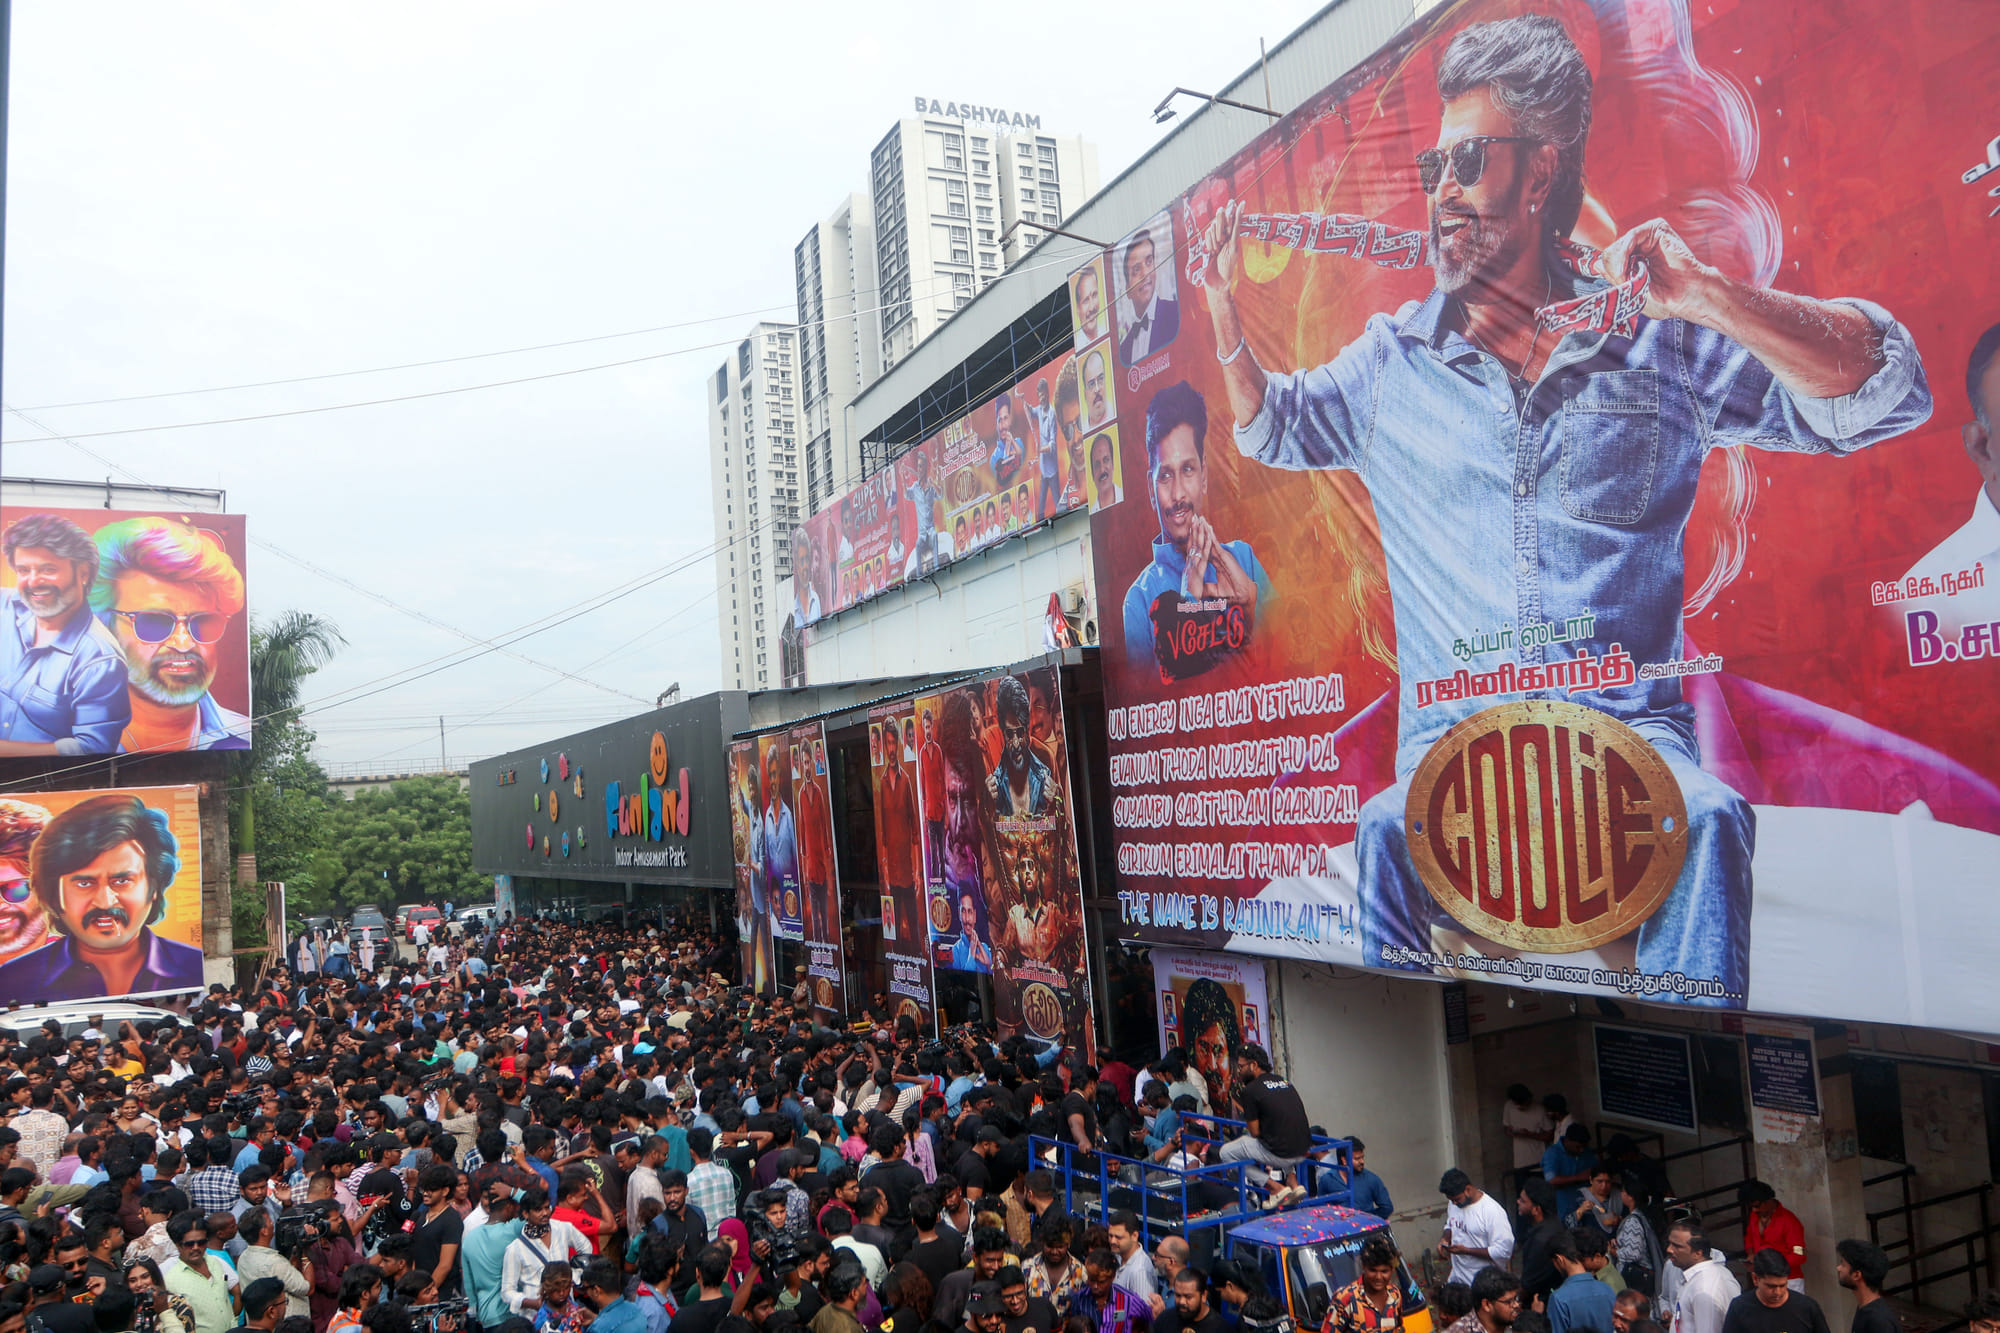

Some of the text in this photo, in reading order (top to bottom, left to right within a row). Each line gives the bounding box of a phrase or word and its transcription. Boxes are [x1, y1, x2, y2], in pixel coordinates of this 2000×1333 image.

[915, 96, 1040, 129] BAASHYAAM
[1871, 561, 1985, 606] கே.கே.நகர்
[1452, 608, 1596, 662] சூப்பர் ஸ்டார்
[1415, 642, 1723, 709] ரஜினிகாந்த் அவர்களின்
[1108, 673, 1345, 740] UN ENERGY INGA ENAI YETHUDA!
[1110, 751, 1160, 786] EVANUM
[1160, 746, 1207, 782] THODA
[1208, 737, 1306, 779] MUDIYATHU
[1113, 784, 1359, 828] SUYAMBU SARITHIRAM PAARUDA!!
[174, 791, 201, 922] THALAIVAR
[615, 845, 688, 867] Indoor Amusement Park
[1118, 841, 1174, 878] SIRIKUM
[1175, 842, 1246, 880] ERIMALAI
[1246, 841, 1302, 880] THANA
[1117, 890, 1355, 944] THE NAME IS RAJINIKANTH
[1457, 954, 1543, 982] வெள்ளிவிழா
[1545, 964, 1589, 984] காண
